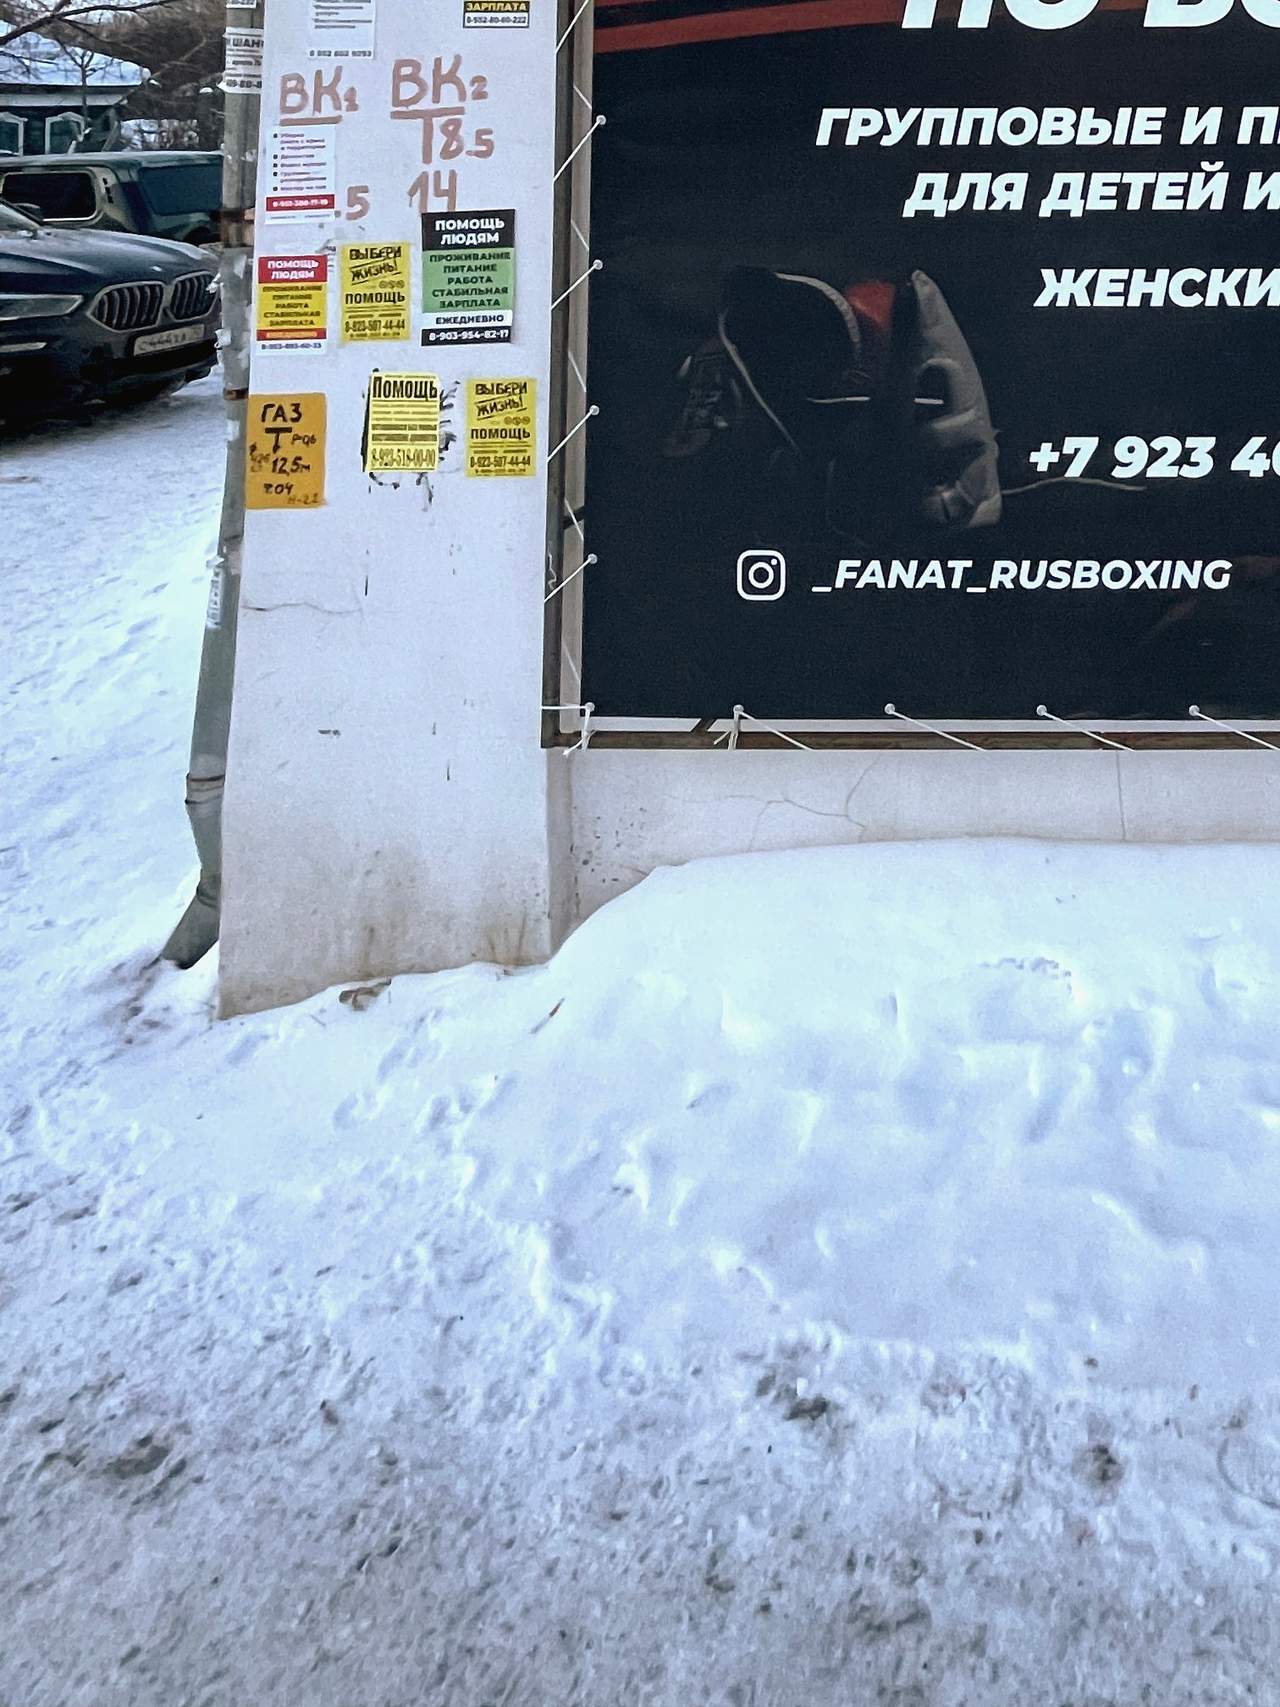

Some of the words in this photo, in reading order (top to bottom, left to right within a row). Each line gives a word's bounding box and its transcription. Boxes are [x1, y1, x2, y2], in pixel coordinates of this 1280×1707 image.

[466, 2, 527, 12] ЗАРПЛАТА
[816, 106, 1169, 147] ГРУППОВЫЕ
[1179, 106, 1225, 146] И
[902, 171, 1025, 218] ДЛЯ
[1038, 160, 1232, 217] ДЕТЕЙ
[435, 218, 505, 232] ПОМОЩЬ
[440, 232, 500, 246] ЛЮДЯМ
[349, 246, 402, 261] ВЫБЕРИ
[429, 252, 511, 262] ПРОЖИВАНИЕ
[267, 260, 319, 269] ПОМОЩЬ
[443, 264, 498, 274] ПИТАНИЕ
[271, 270, 315, 280] ЛЮДЯМ
[447, 276, 493, 285] РАБОТА
[345, 291, 406, 305] ПОМОЩЬ
[432, 287, 509, 298] СТАБИЛЬНАЯ
[439, 299, 501, 309] ЗАРПЛАТА
[435, 314, 505, 325] ЕЖЕДНЕВНО
[475, 381, 528, 396] ВЫБЕРИ
[261, 402, 303, 423] ГАЗ
[470, 427, 531, 441] ПОМОЩЬ
[1029, 436, 1099, 480] +7
[1110, 436, 1217, 479] 923
[811, 559, 1234, 594] _FANAT_RUSBOXING
